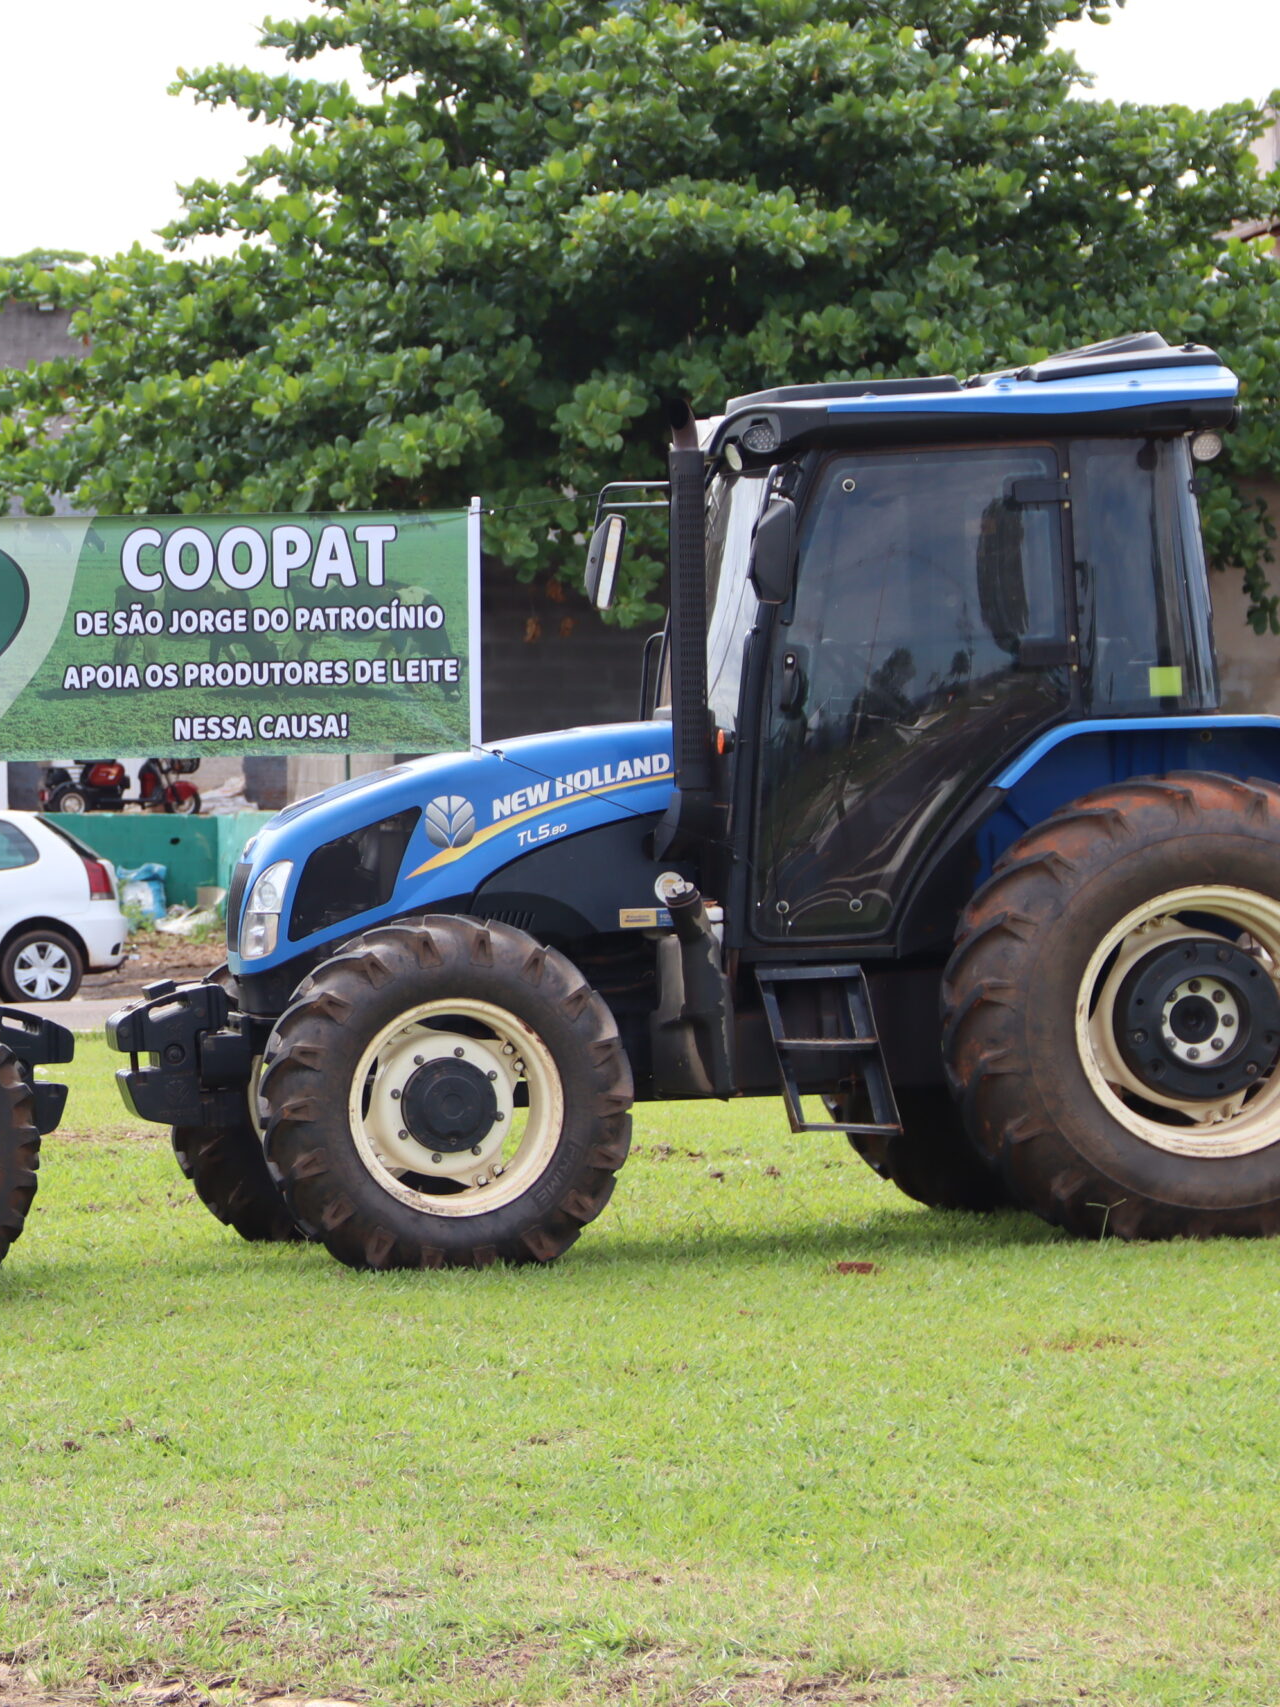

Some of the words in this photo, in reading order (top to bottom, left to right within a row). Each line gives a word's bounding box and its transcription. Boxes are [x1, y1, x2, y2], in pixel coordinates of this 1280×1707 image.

[120, 523, 398, 592] COOPAT
[74, 610, 108, 636] DE
[113, 603, 164, 636] SÃO
[168, 608, 248, 635] JORGE
[253, 607, 290, 634] DO
[295, 598, 445, 633] PATROCÍNIO
[63, 663, 140, 691] APOIA
[144, 662, 179, 689] OS
[183, 660, 349, 688] PRODUTORES
[354, 659, 387, 685] DE
[392, 658, 460, 684] LEITE
[173, 714, 253, 742] NESSA
[258, 713, 349, 740] CAUSA!
[492, 780, 550, 821] NEW
[555, 753, 670, 798] HOLLAND
